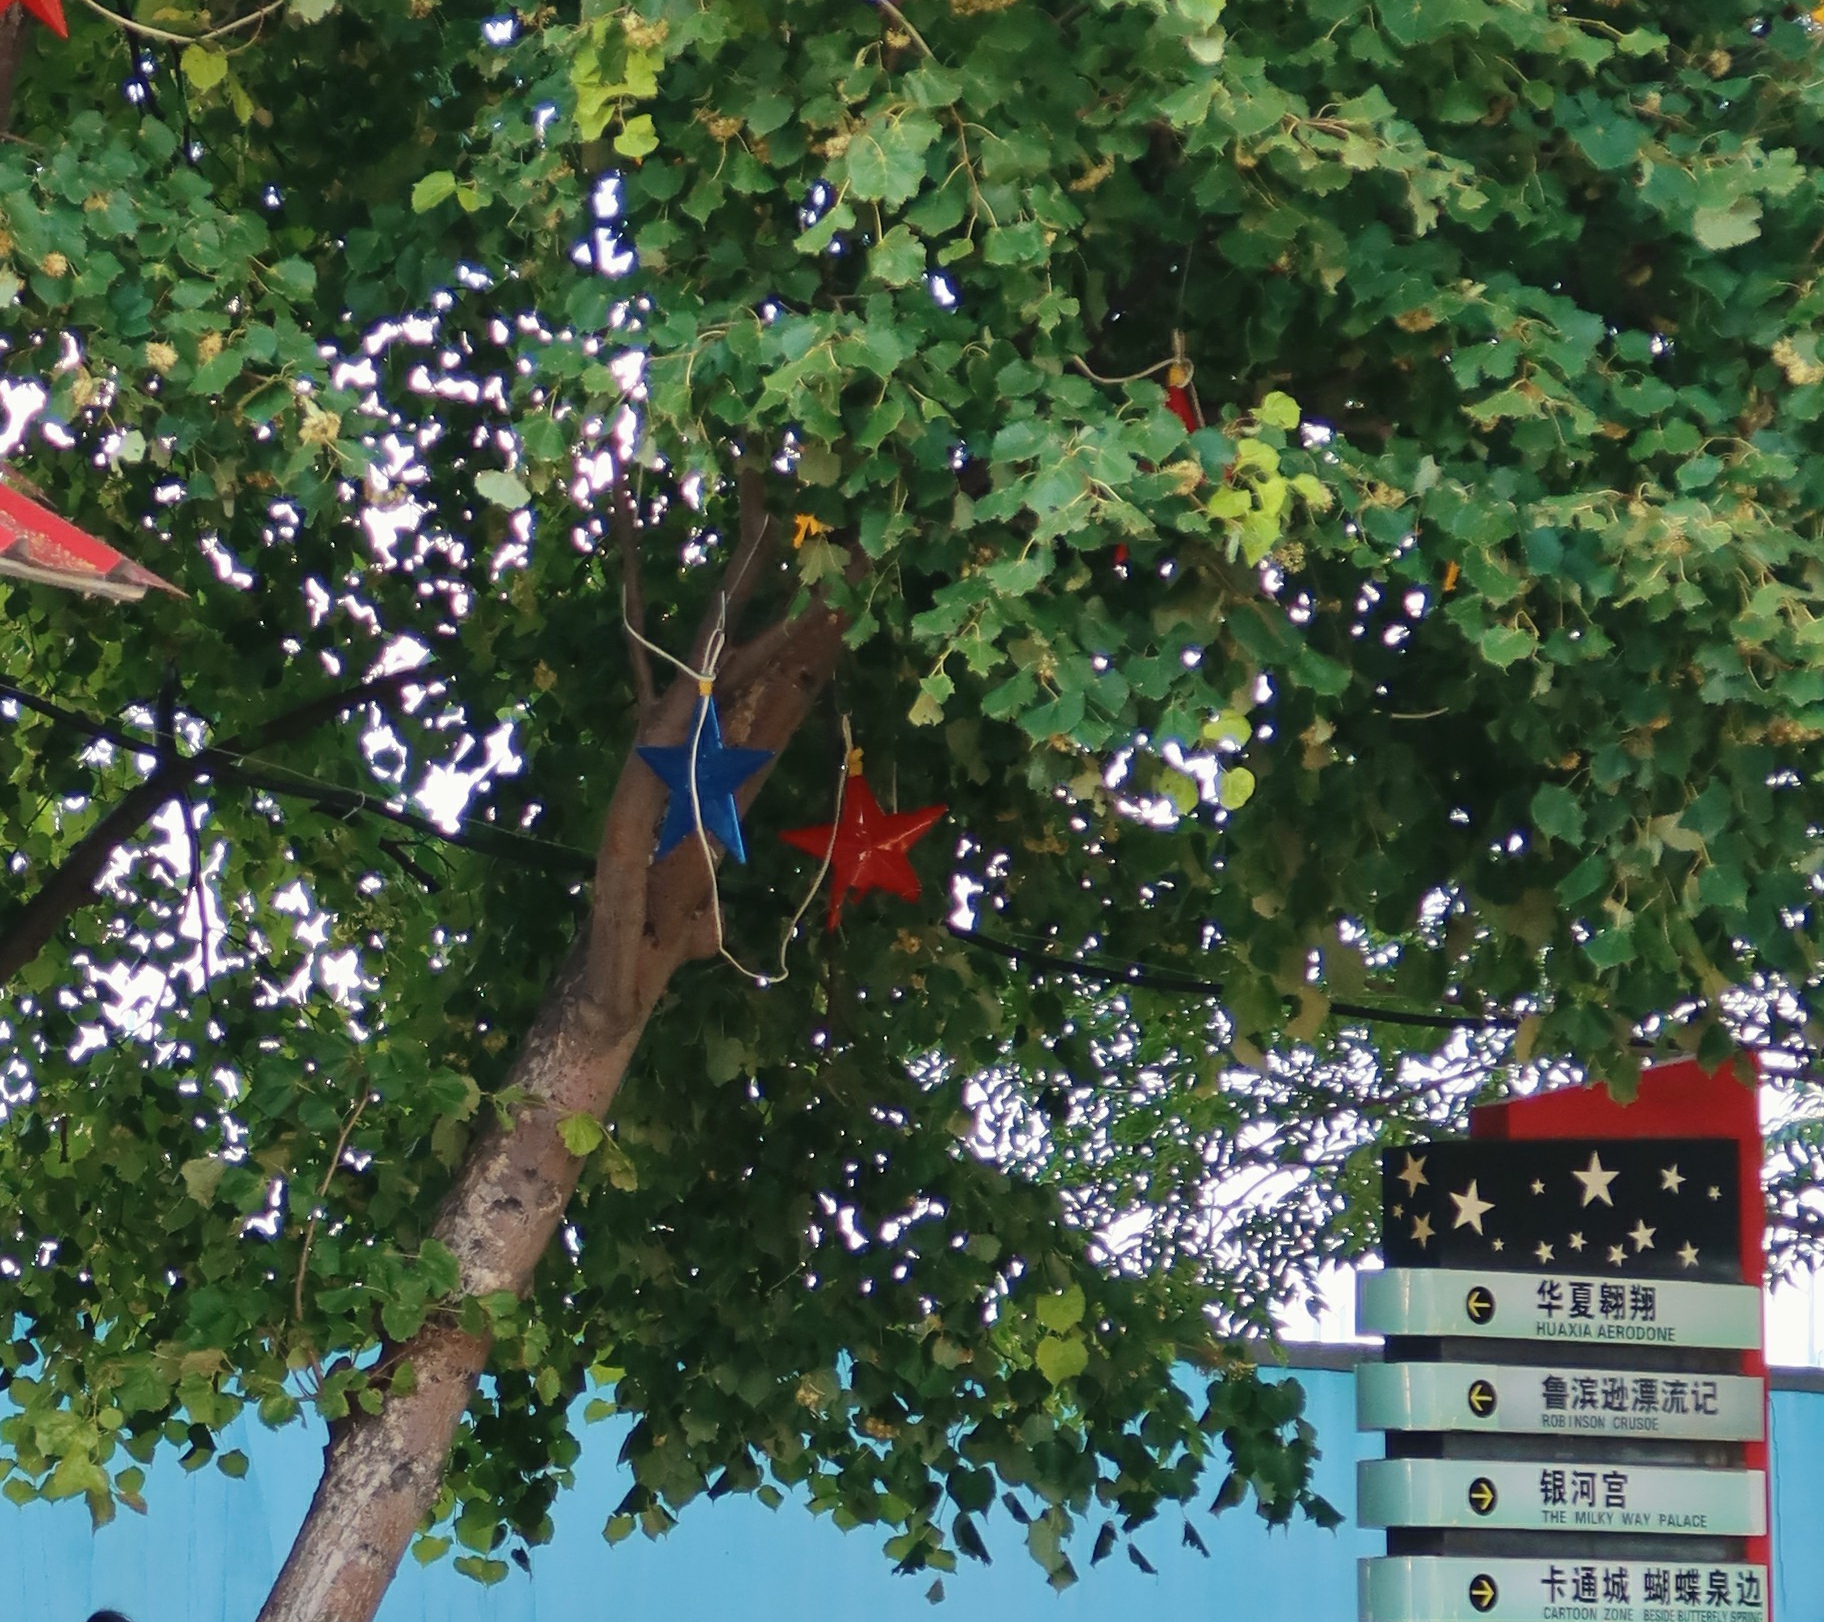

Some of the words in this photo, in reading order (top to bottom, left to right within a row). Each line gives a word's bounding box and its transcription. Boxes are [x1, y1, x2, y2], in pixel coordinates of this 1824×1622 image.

[1536, 1279, 1656, 1321] 华夏翱翔
[1536, 1321, 1593, 1338] HUAXIA
[1597, 1324, 1676, 1342] AERODONE
[1541, 1374, 1719, 1416] 鲁滨逊漂流记
[1542, 1414, 1605, 1429] ROBINSON
[1613, 1417, 1660, 1431] CRUSOE
[1540, 1468, 1628, 1509] 银河宫
[1542, 1510, 1567, 1524] THE
[1576, 1511, 1614, 1525] MILKY
[1622, 1512, 1651, 1526] WAY
[1659, 1513, 1707, 1528] PALACE
[1541, 1565, 1630, 1605] 卡通城
[1643, 1568, 1764, 1608] 蝴蝶泉边
[1543, 1607, 1597, 1621] CARTOON
[1604, 1608, 1634, 1622] ZONE
[1643, 1609, 1675, 1622] BESIDE
